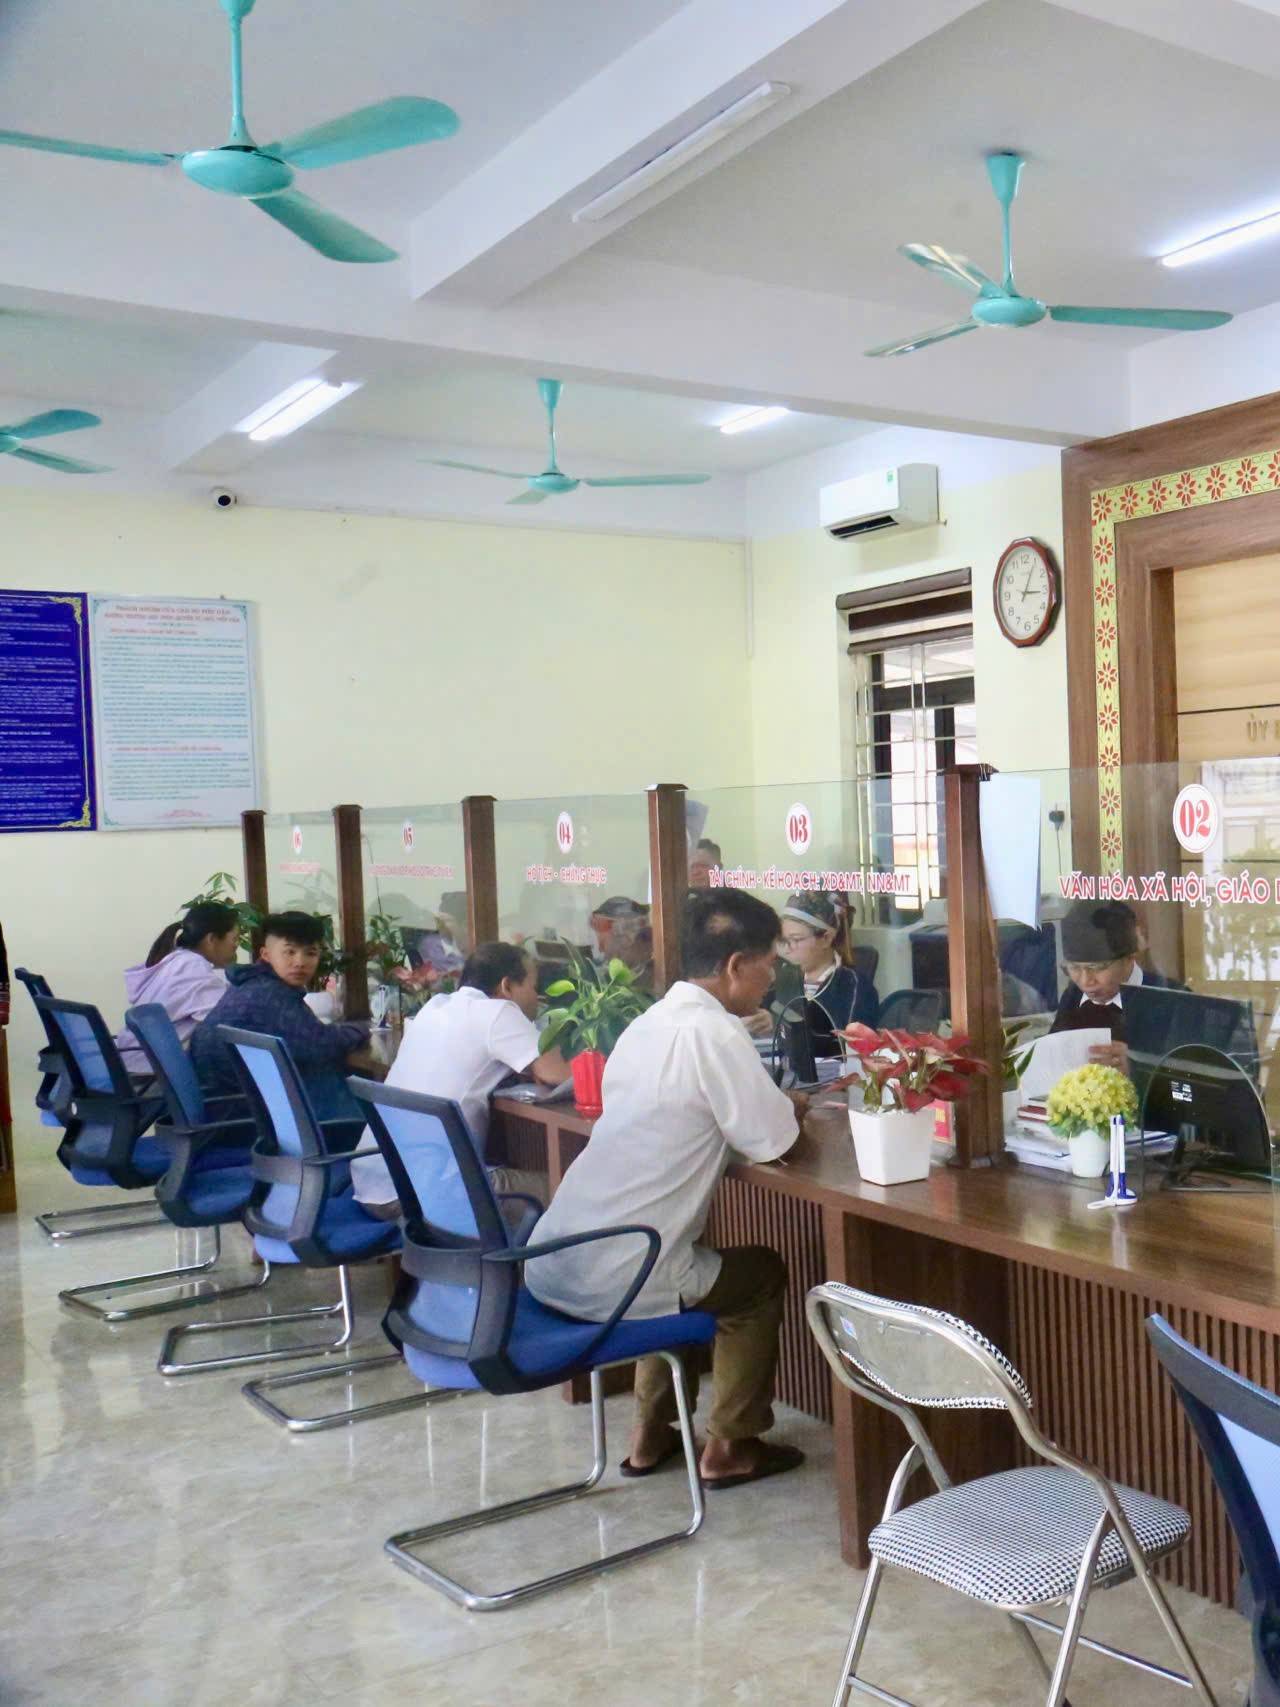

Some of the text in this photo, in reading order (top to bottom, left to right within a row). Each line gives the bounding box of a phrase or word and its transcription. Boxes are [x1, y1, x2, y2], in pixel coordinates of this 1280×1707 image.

[1021, 552, 1030, 564] 12
[1012, 560, 1019, 569] 11
[1040, 569, 1046, 578] 2
[1006, 575, 1015, 585] 10
[1004, 591, 1011, 601] 9
[1008, 606, 1015, 616] 8
[1033, 615, 1040, 624] 5
[1024, 621, 1031, 632] 6
[1179, 799, 1212, 838] 02
[559, 821, 572, 844] 04
[789, 815, 808, 844] 03
[708, 864, 724, 889] TÀI
[725, 864, 757, 889] CHÍNH
[762, 863, 777, 890] KẾ
[866, 872, 911, 894] NN&MT
[1058, 870, 1096, 900] VĂN
[1098, 870, 1139, 901] HÓA
[1141, 870, 1169, 901] XÃ
[1171, 869, 1212, 907] HỘI,
[1216, 870, 1271, 905] GIÁO
